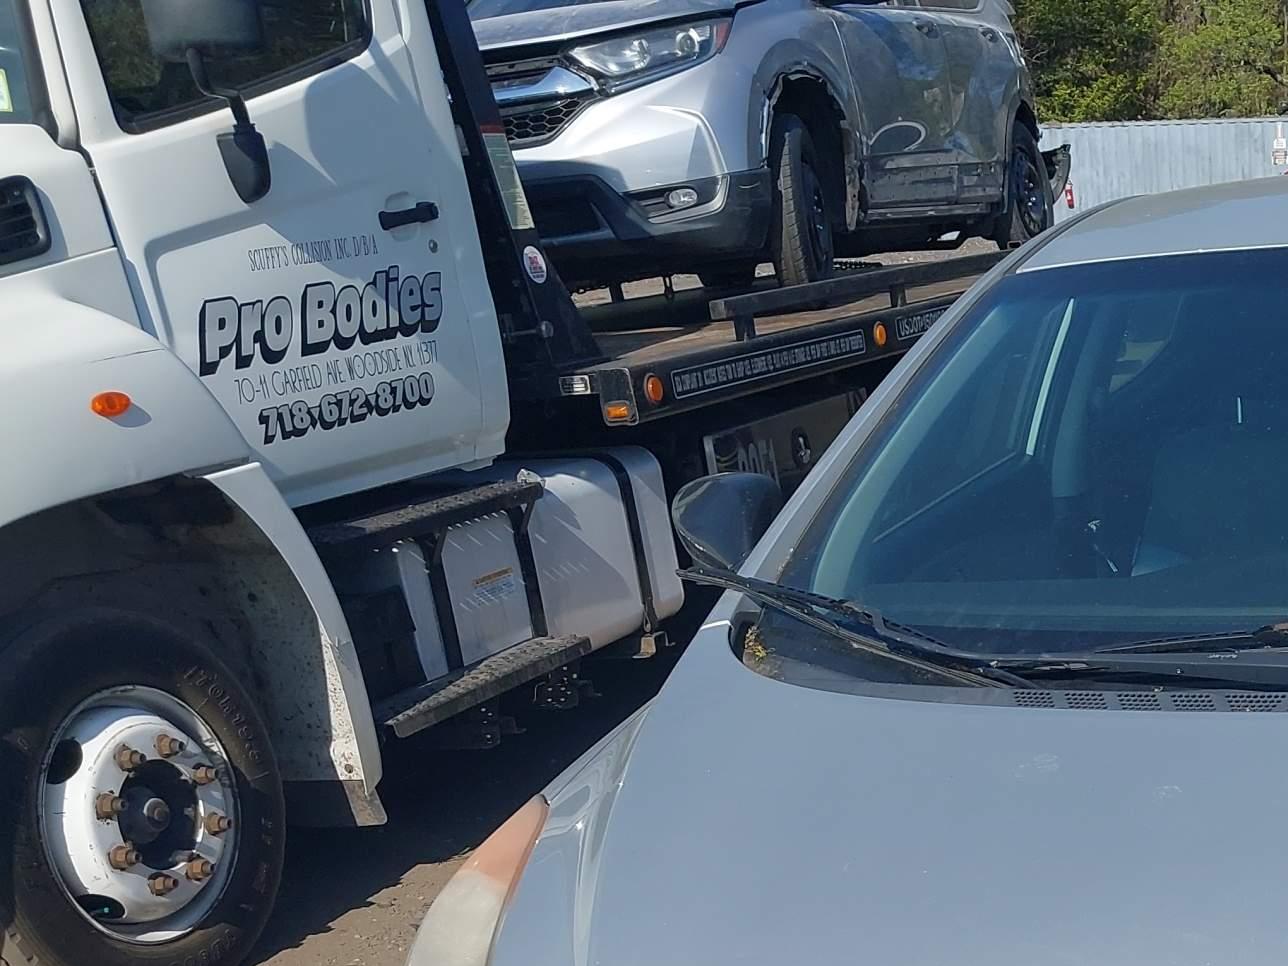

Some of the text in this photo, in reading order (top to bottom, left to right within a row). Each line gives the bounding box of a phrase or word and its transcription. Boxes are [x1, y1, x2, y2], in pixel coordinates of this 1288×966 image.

[248, 245, 289, 271] SCUFFY'S
[352, 234, 378, 257] D/B/A
[199, 264, 443, 377] Pro Bodies
[234, 376, 270, 405] 70-11
[272, 363, 323, 396] GARFIELD
[347, 348, 402, 382] WOODSIDE
